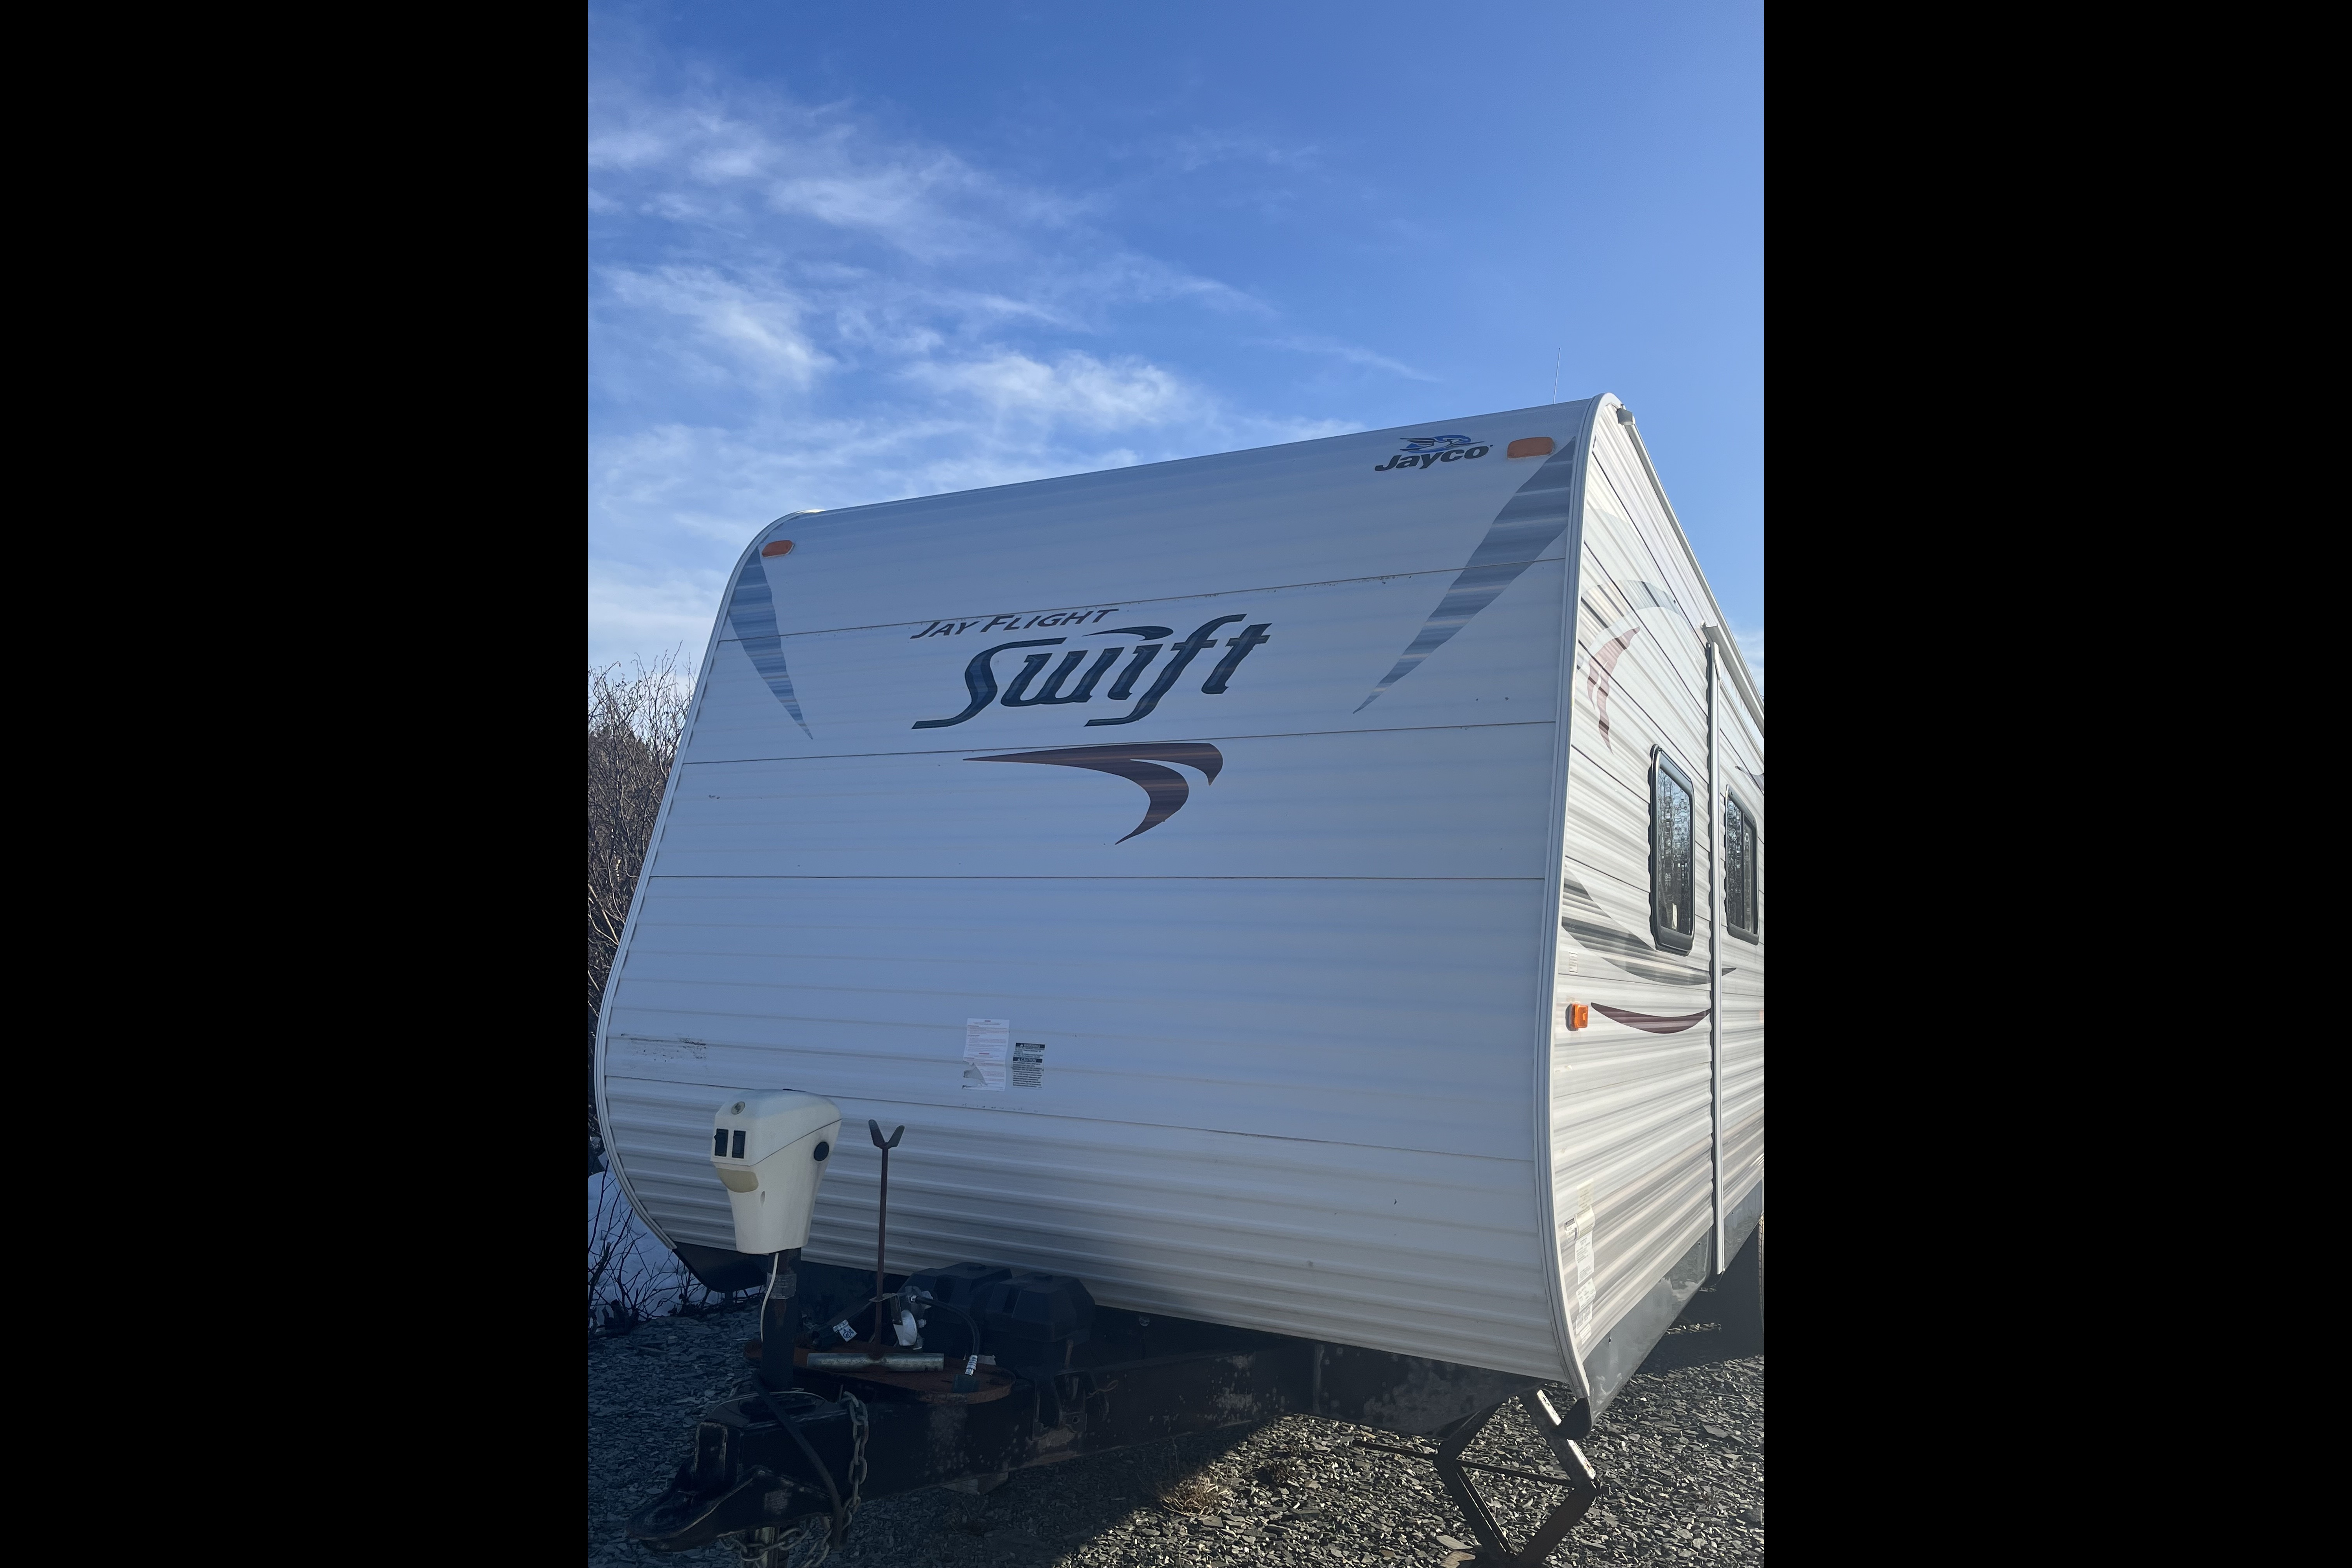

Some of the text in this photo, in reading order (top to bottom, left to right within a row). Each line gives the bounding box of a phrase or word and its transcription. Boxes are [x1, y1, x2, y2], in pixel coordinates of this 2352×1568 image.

[1374, 446, 1489, 472] Jayco
[910, 608, 1119, 639] JAY FLIGHT
[911, 613, 1272, 729] Swift
